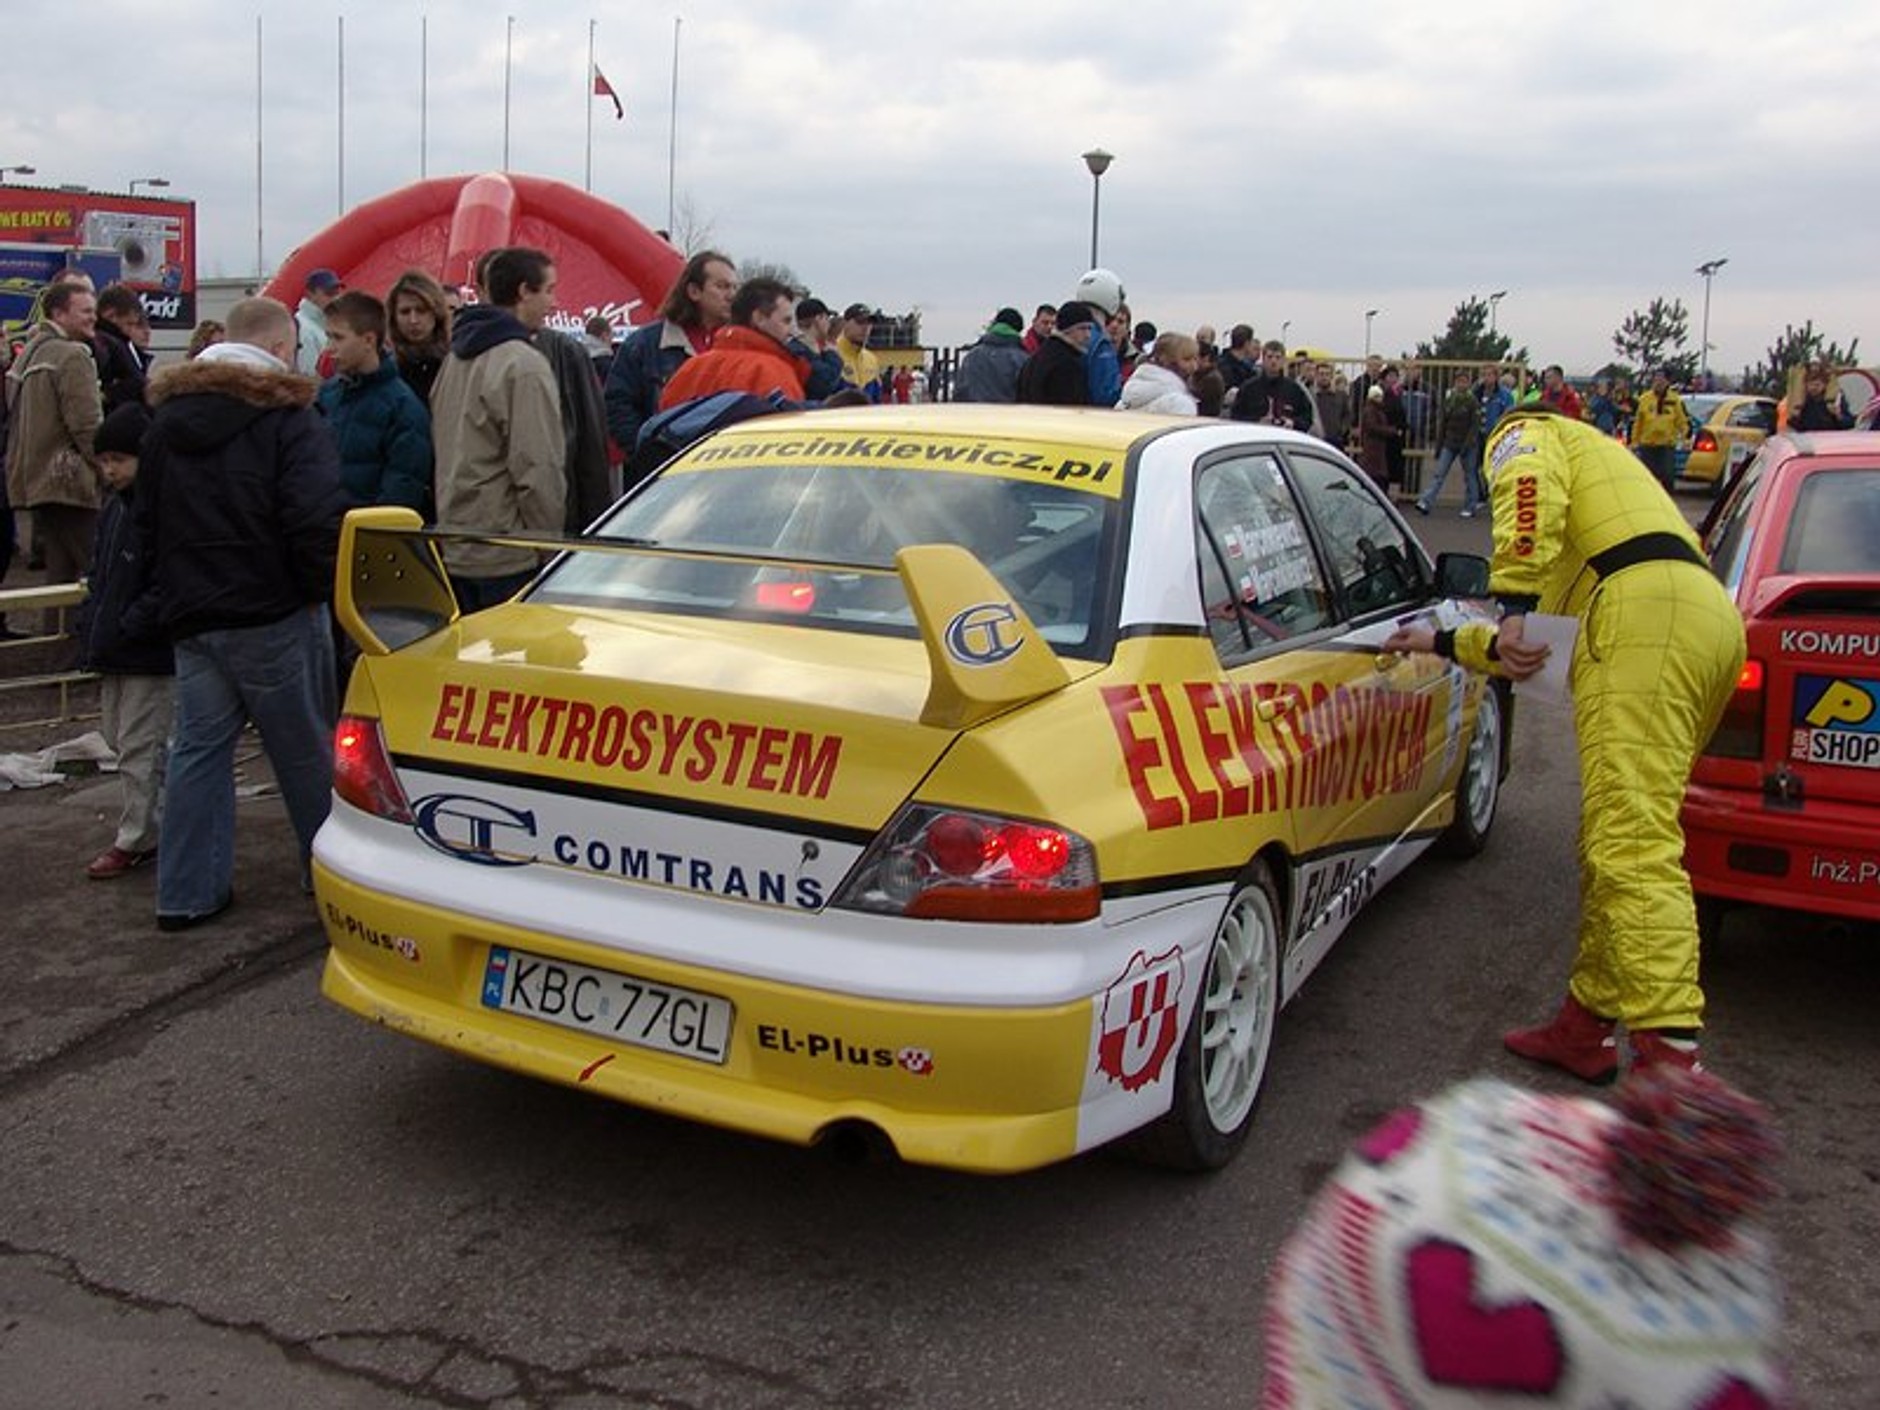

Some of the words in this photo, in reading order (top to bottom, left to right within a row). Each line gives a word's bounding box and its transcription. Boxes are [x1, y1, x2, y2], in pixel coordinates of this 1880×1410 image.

[691, 437, 1112, 484] marcinkiewicz.pl
[1516, 475, 1537, 533] LOTOS
[431, 683, 843, 800] ELEKTROSYSTEM
[1100, 680, 1434, 832] ELEKTROSYSTEM
[1812, 732, 1880, 763] SHOP
[553, 834, 824, 911] COMTRANS
[509, 958, 602, 1023] KBC
[613, 982, 722, 1057] 77GL
